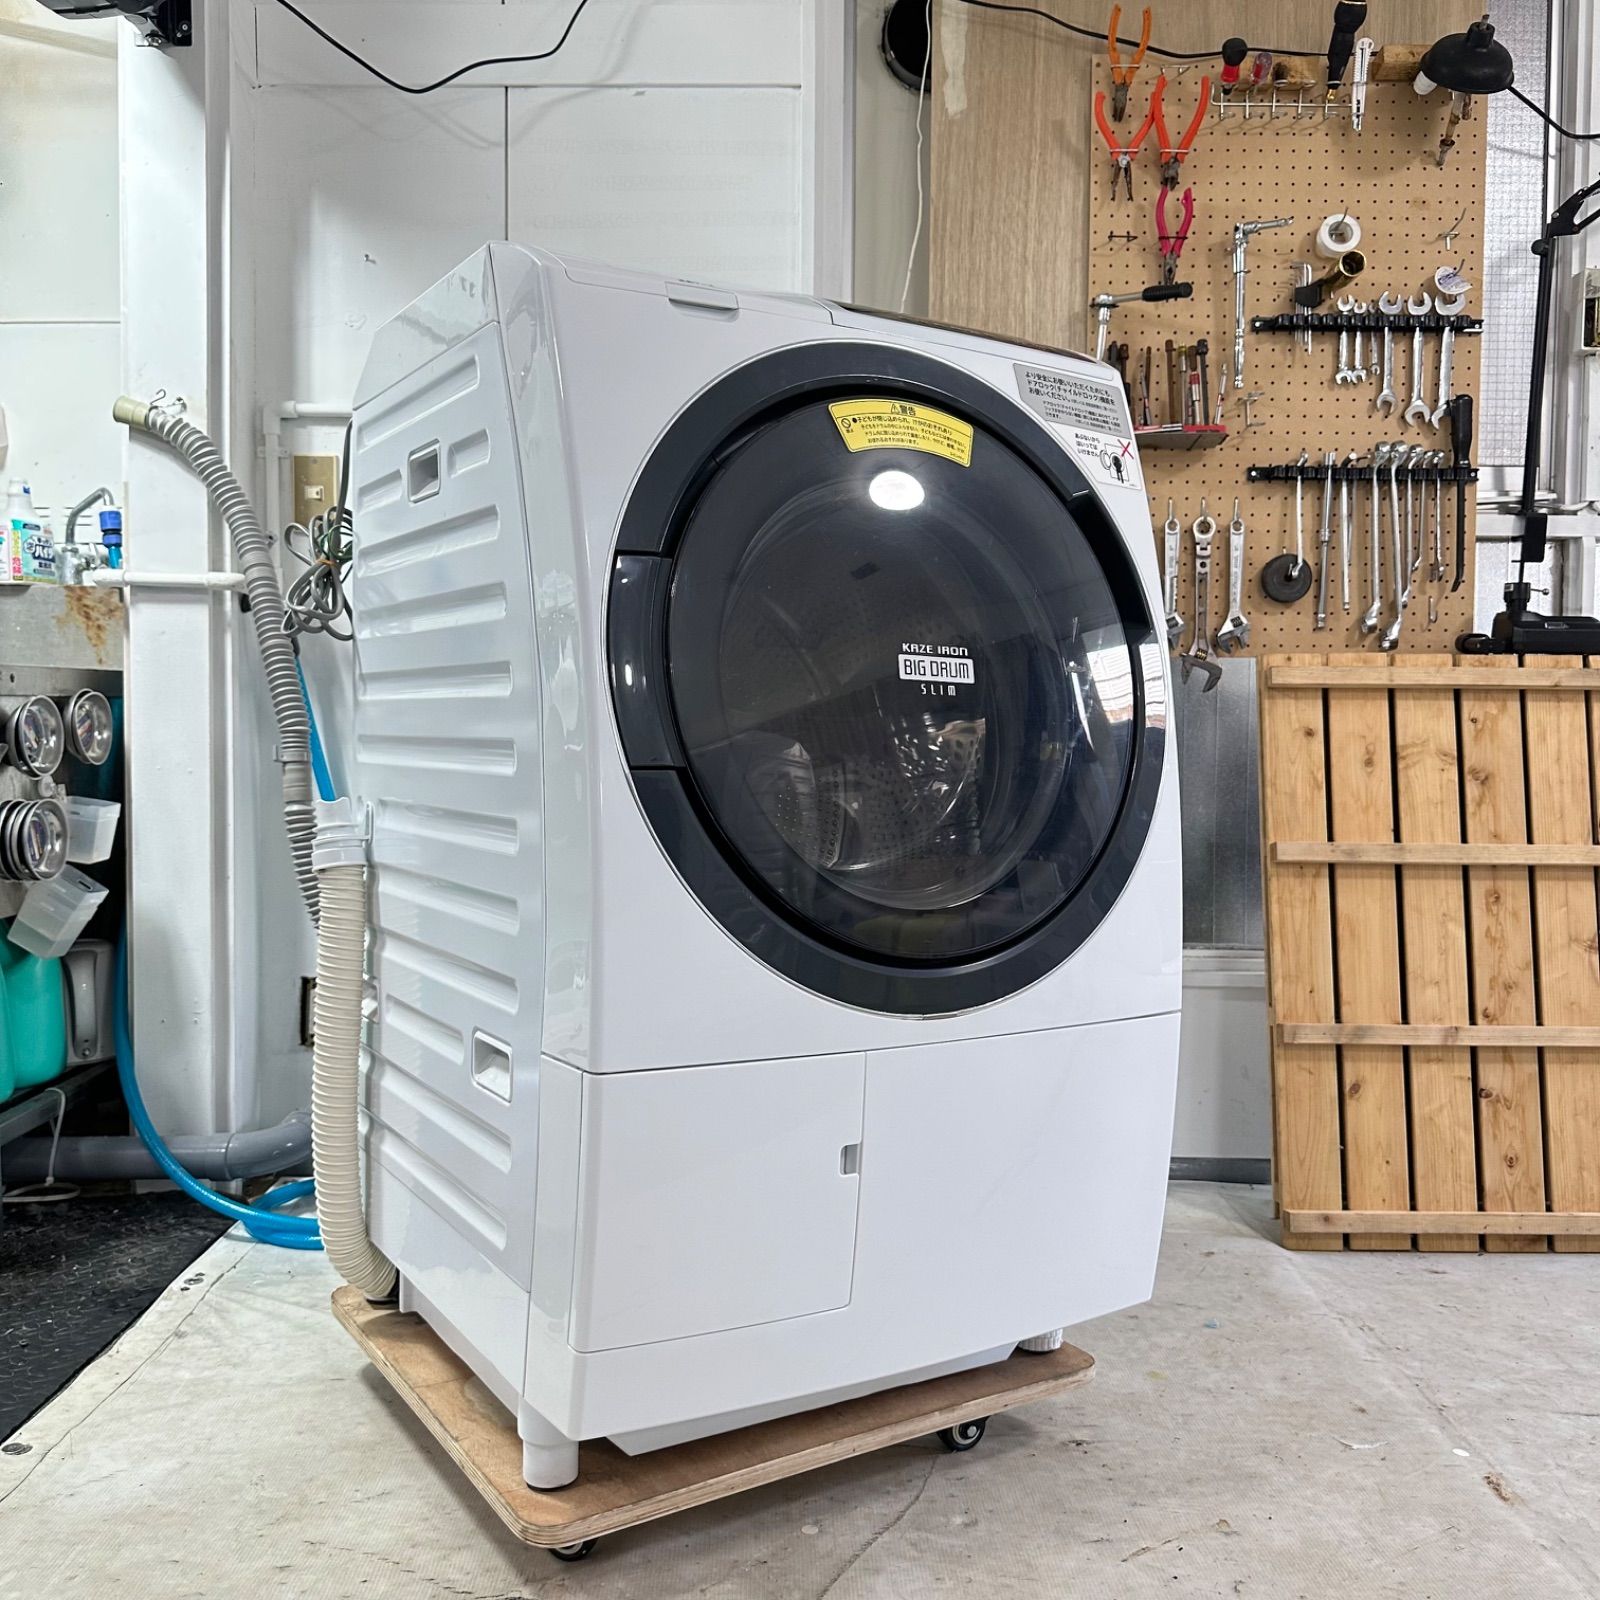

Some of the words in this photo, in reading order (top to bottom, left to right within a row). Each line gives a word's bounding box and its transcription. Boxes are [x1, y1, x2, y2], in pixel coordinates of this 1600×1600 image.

[902, 642, 933, 654] KAZE
[937, 645, 968, 656] IRON
[904, 659, 926, 676] BIG
[930, 660, 969, 679] DRUM
[921, 683, 956, 696] SLIM
